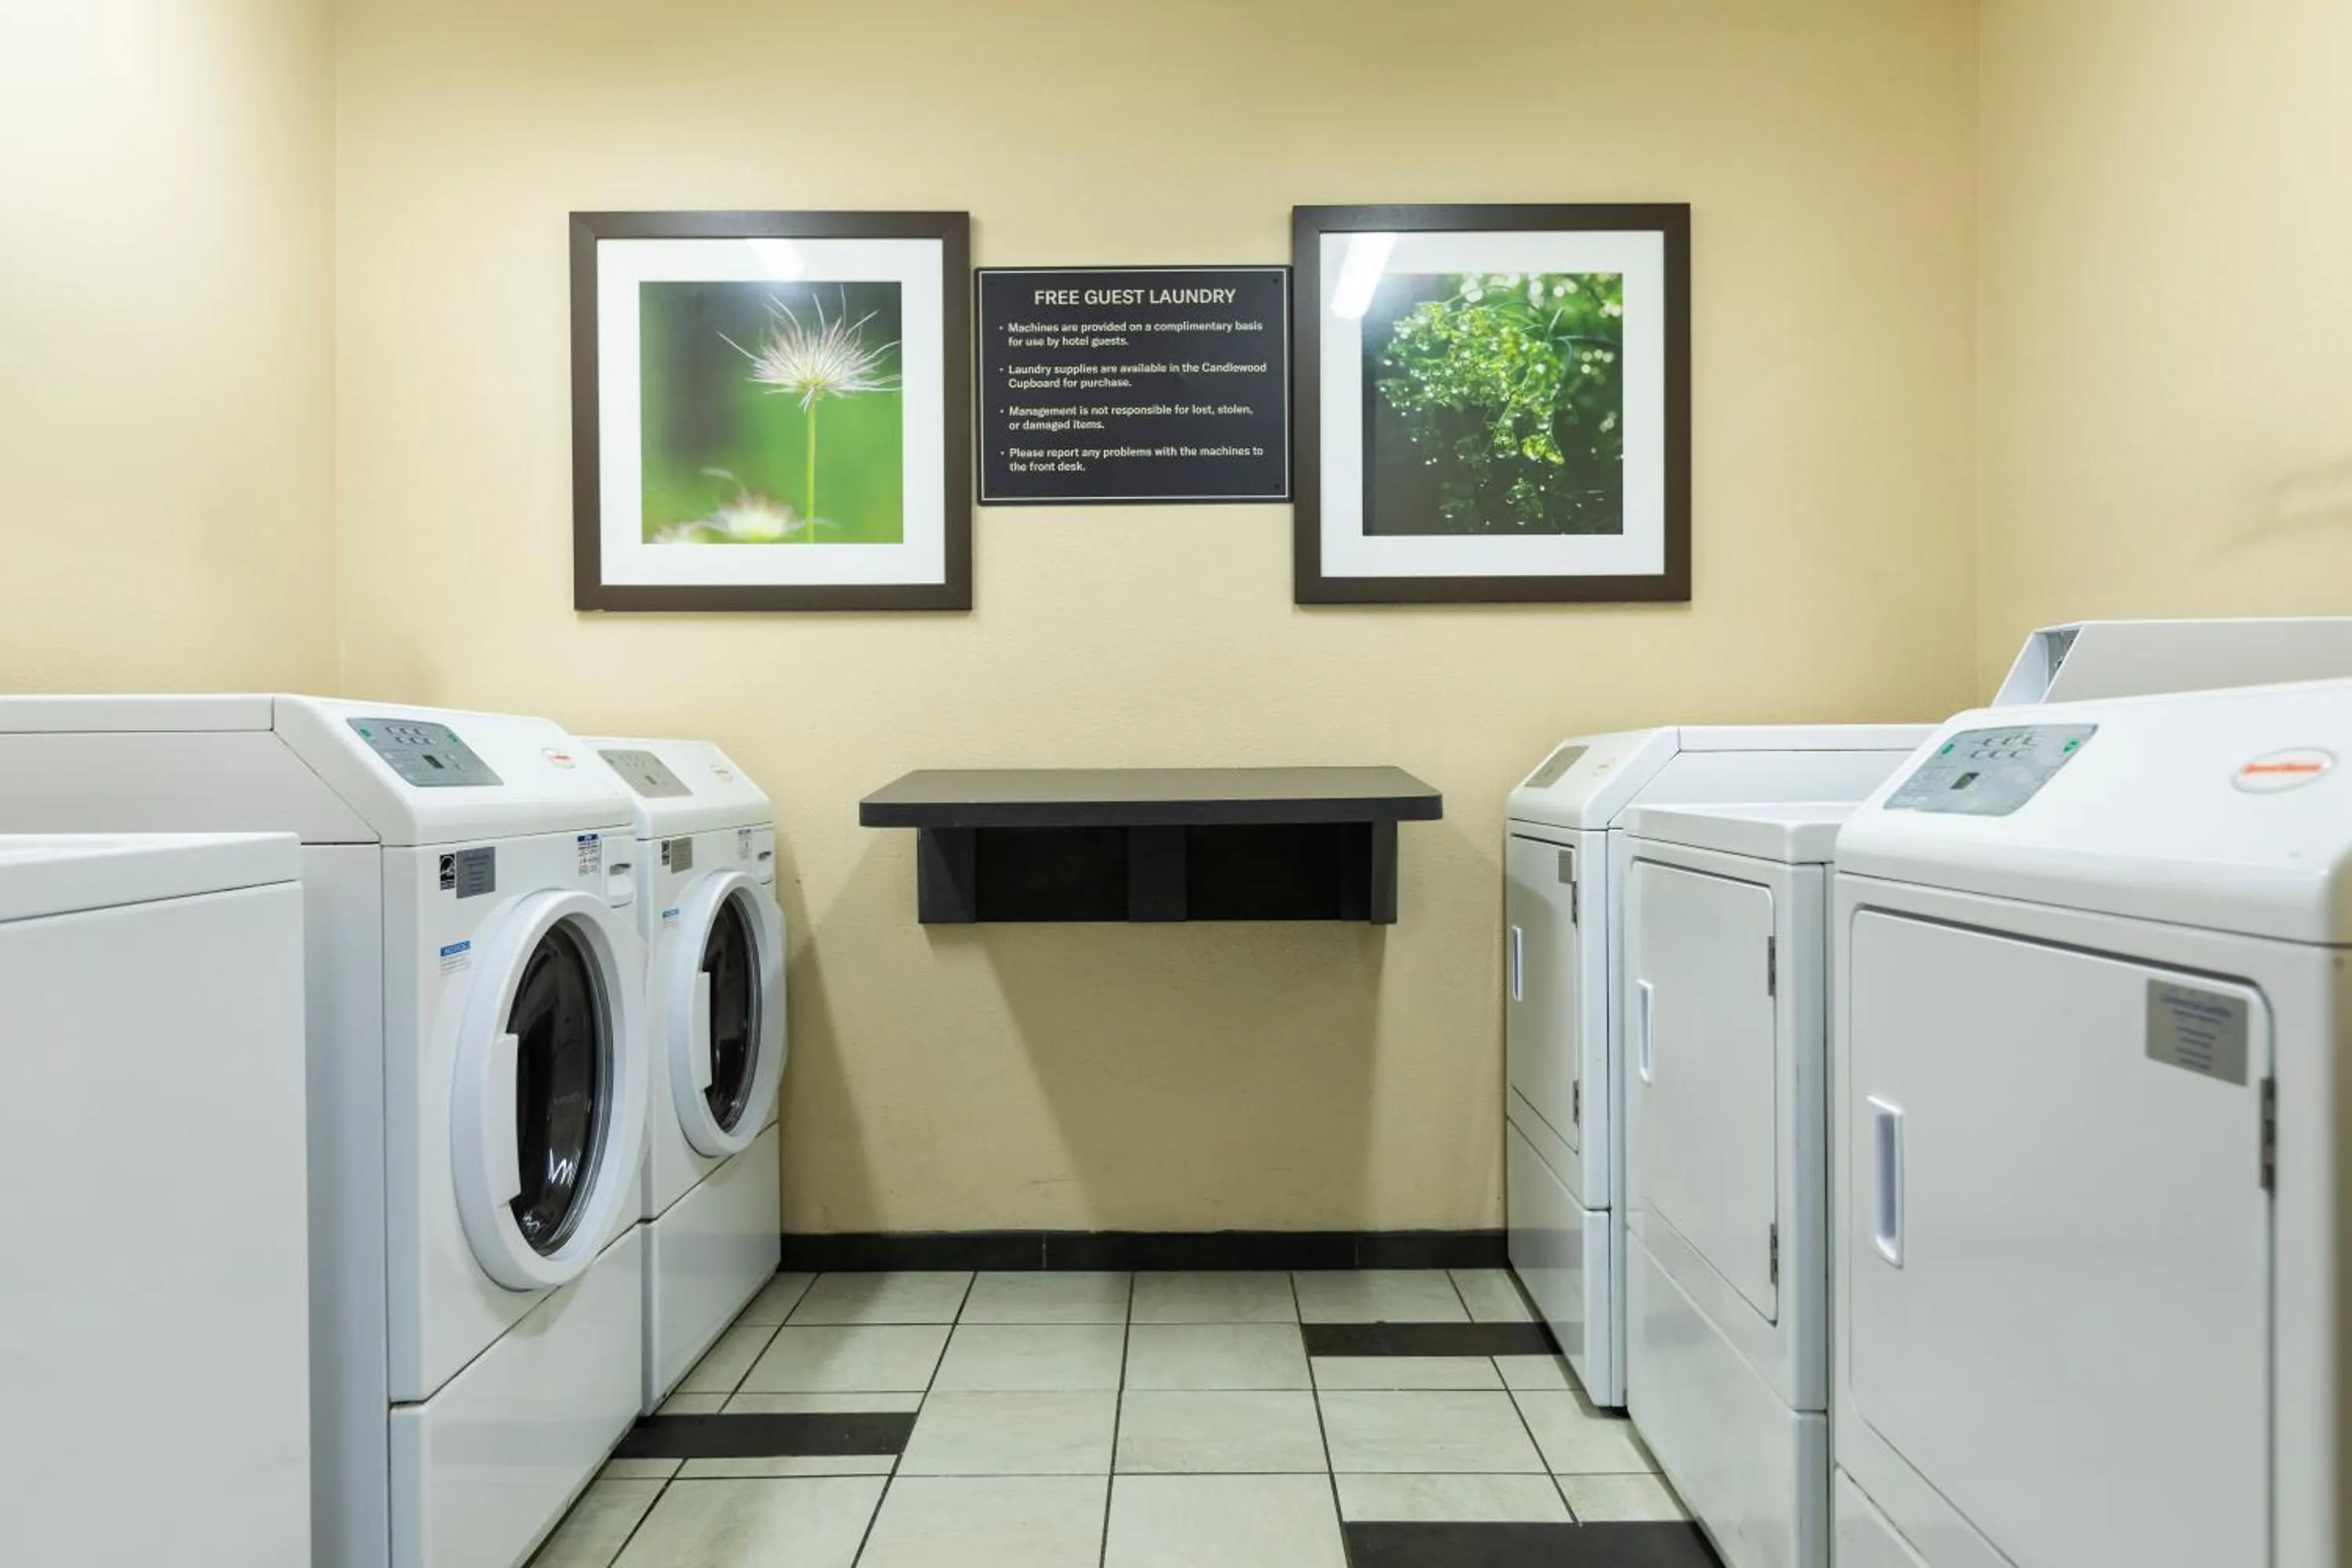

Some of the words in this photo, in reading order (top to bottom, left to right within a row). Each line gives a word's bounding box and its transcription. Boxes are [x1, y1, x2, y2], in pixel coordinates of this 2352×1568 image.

[1034, 289, 1080, 306] FREE
[1083, 289, 1146, 306] GUEST
[1149, 288, 1236, 304] LAUNDRY
[1007, 322, 1060, 333] Machines
[1061, 324, 1079, 332] are
[1080, 321, 1127, 335] provided
[1128, 323, 1143, 332] on
[1144, 323, 1152, 332] a
[1153, 321, 1233, 334] complimentary
[1234, 319, 1264, 332] basis
[1007, 336, 1024, 347] for
[1025, 338, 1045, 347] use
[1047, 336, 1061, 349] by
[1062, 335, 1089, 346] hotel
[1091, 336, 1129, 349] guests.
[1008, 363, 1052, 376] Laundry
[1054, 363, 1098, 376] supplies
[1100, 365, 1118, 374] are
[1119, 363, 1167, 374] available
[1169, 363, 1180, 372] in
[1181, 362, 1200, 373] the
[1201, 361, 1268, 373] Candlewood
[1007, 377, 1061, 390] Cupboard
[1062, 377, 1078, 388] for
[1080, 377, 1132, 390] purchase.
[1009, 405, 1077, 419] Management
[1079, 405, 1089, 416] is
[1091, 405, 1109, 416] not
[1111, 404, 1173, 417] responsible
[1174, 404, 1190, 415] for
[1191, 404, 1215, 416] lost,
[1217, 403, 1254, 416] stolen,
[1008, 422, 1021, 430] or
[1022, 419, 1070, 432] damaged
[1073, 419, 1105, 430] items.
[1009, 447, 1045, 459] Please
[1047, 448, 1080, 459] report
[1081, 448, 1102, 459] any
[1102, 446, 1152, 459] problems
[1153, 446, 1178, 457] with
[1179, 445, 1197, 456] the
[1200, 445, 1251, 456] machines
[1251, 446, 1264, 456] to
[1009, 461, 1028, 473] the
[1029, 461, 1056, 472] front
[1057, 460, 1086, 471] desk.
